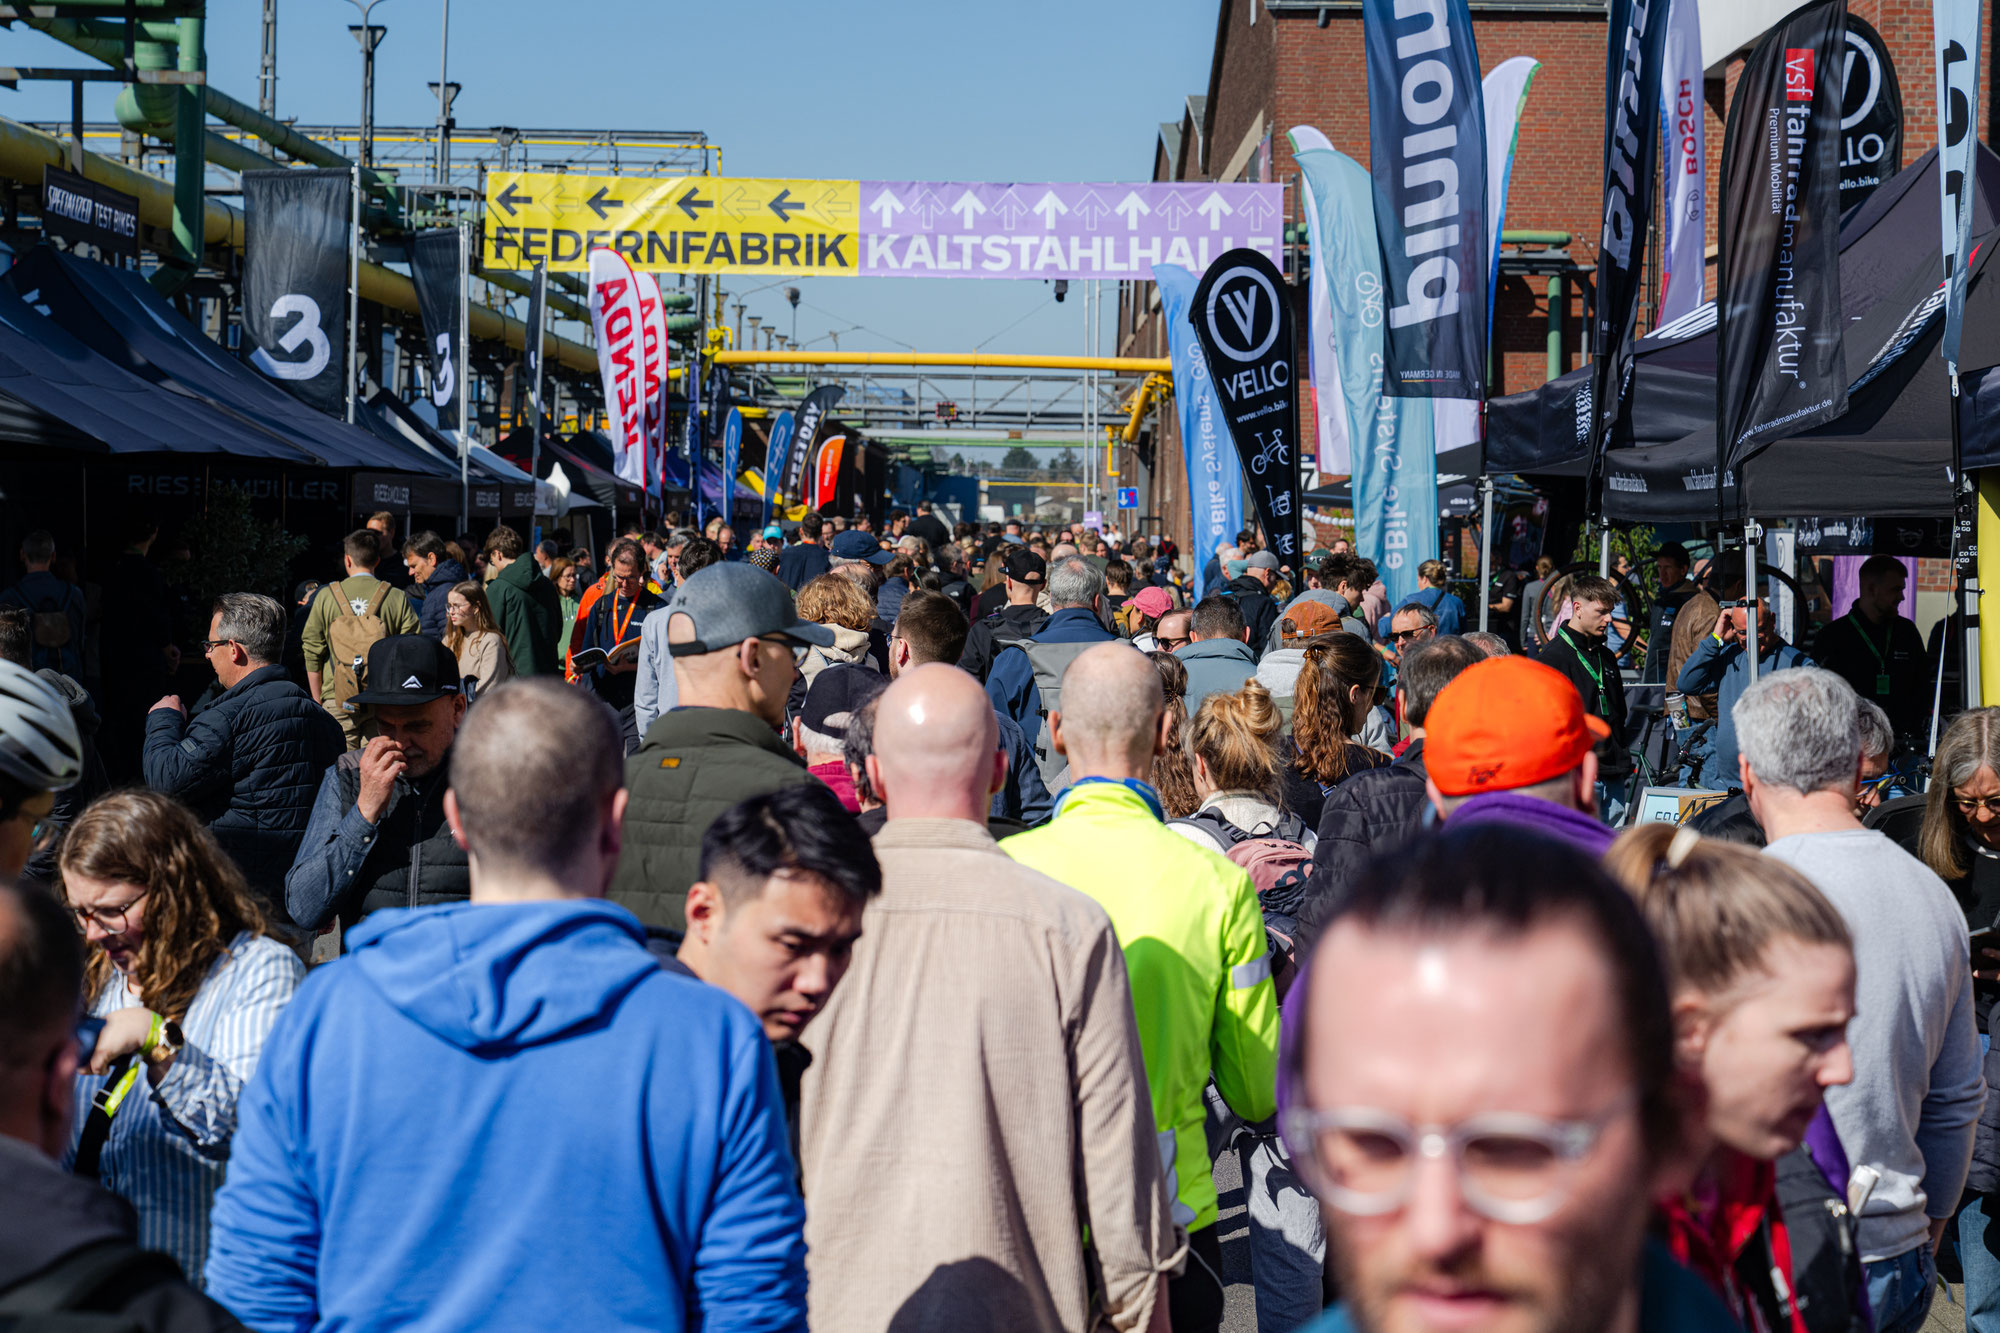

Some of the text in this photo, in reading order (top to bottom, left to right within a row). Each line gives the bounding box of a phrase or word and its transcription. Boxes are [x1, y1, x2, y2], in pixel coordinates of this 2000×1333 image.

[1786, 57, 1813, 97] vsf
[1769, 108, 1783, 214] Premium Mobilität
[46, 185, 136, 238] SPECIALIZED TEST BIKES
[1222, 360, 1288, 401] VELLO
